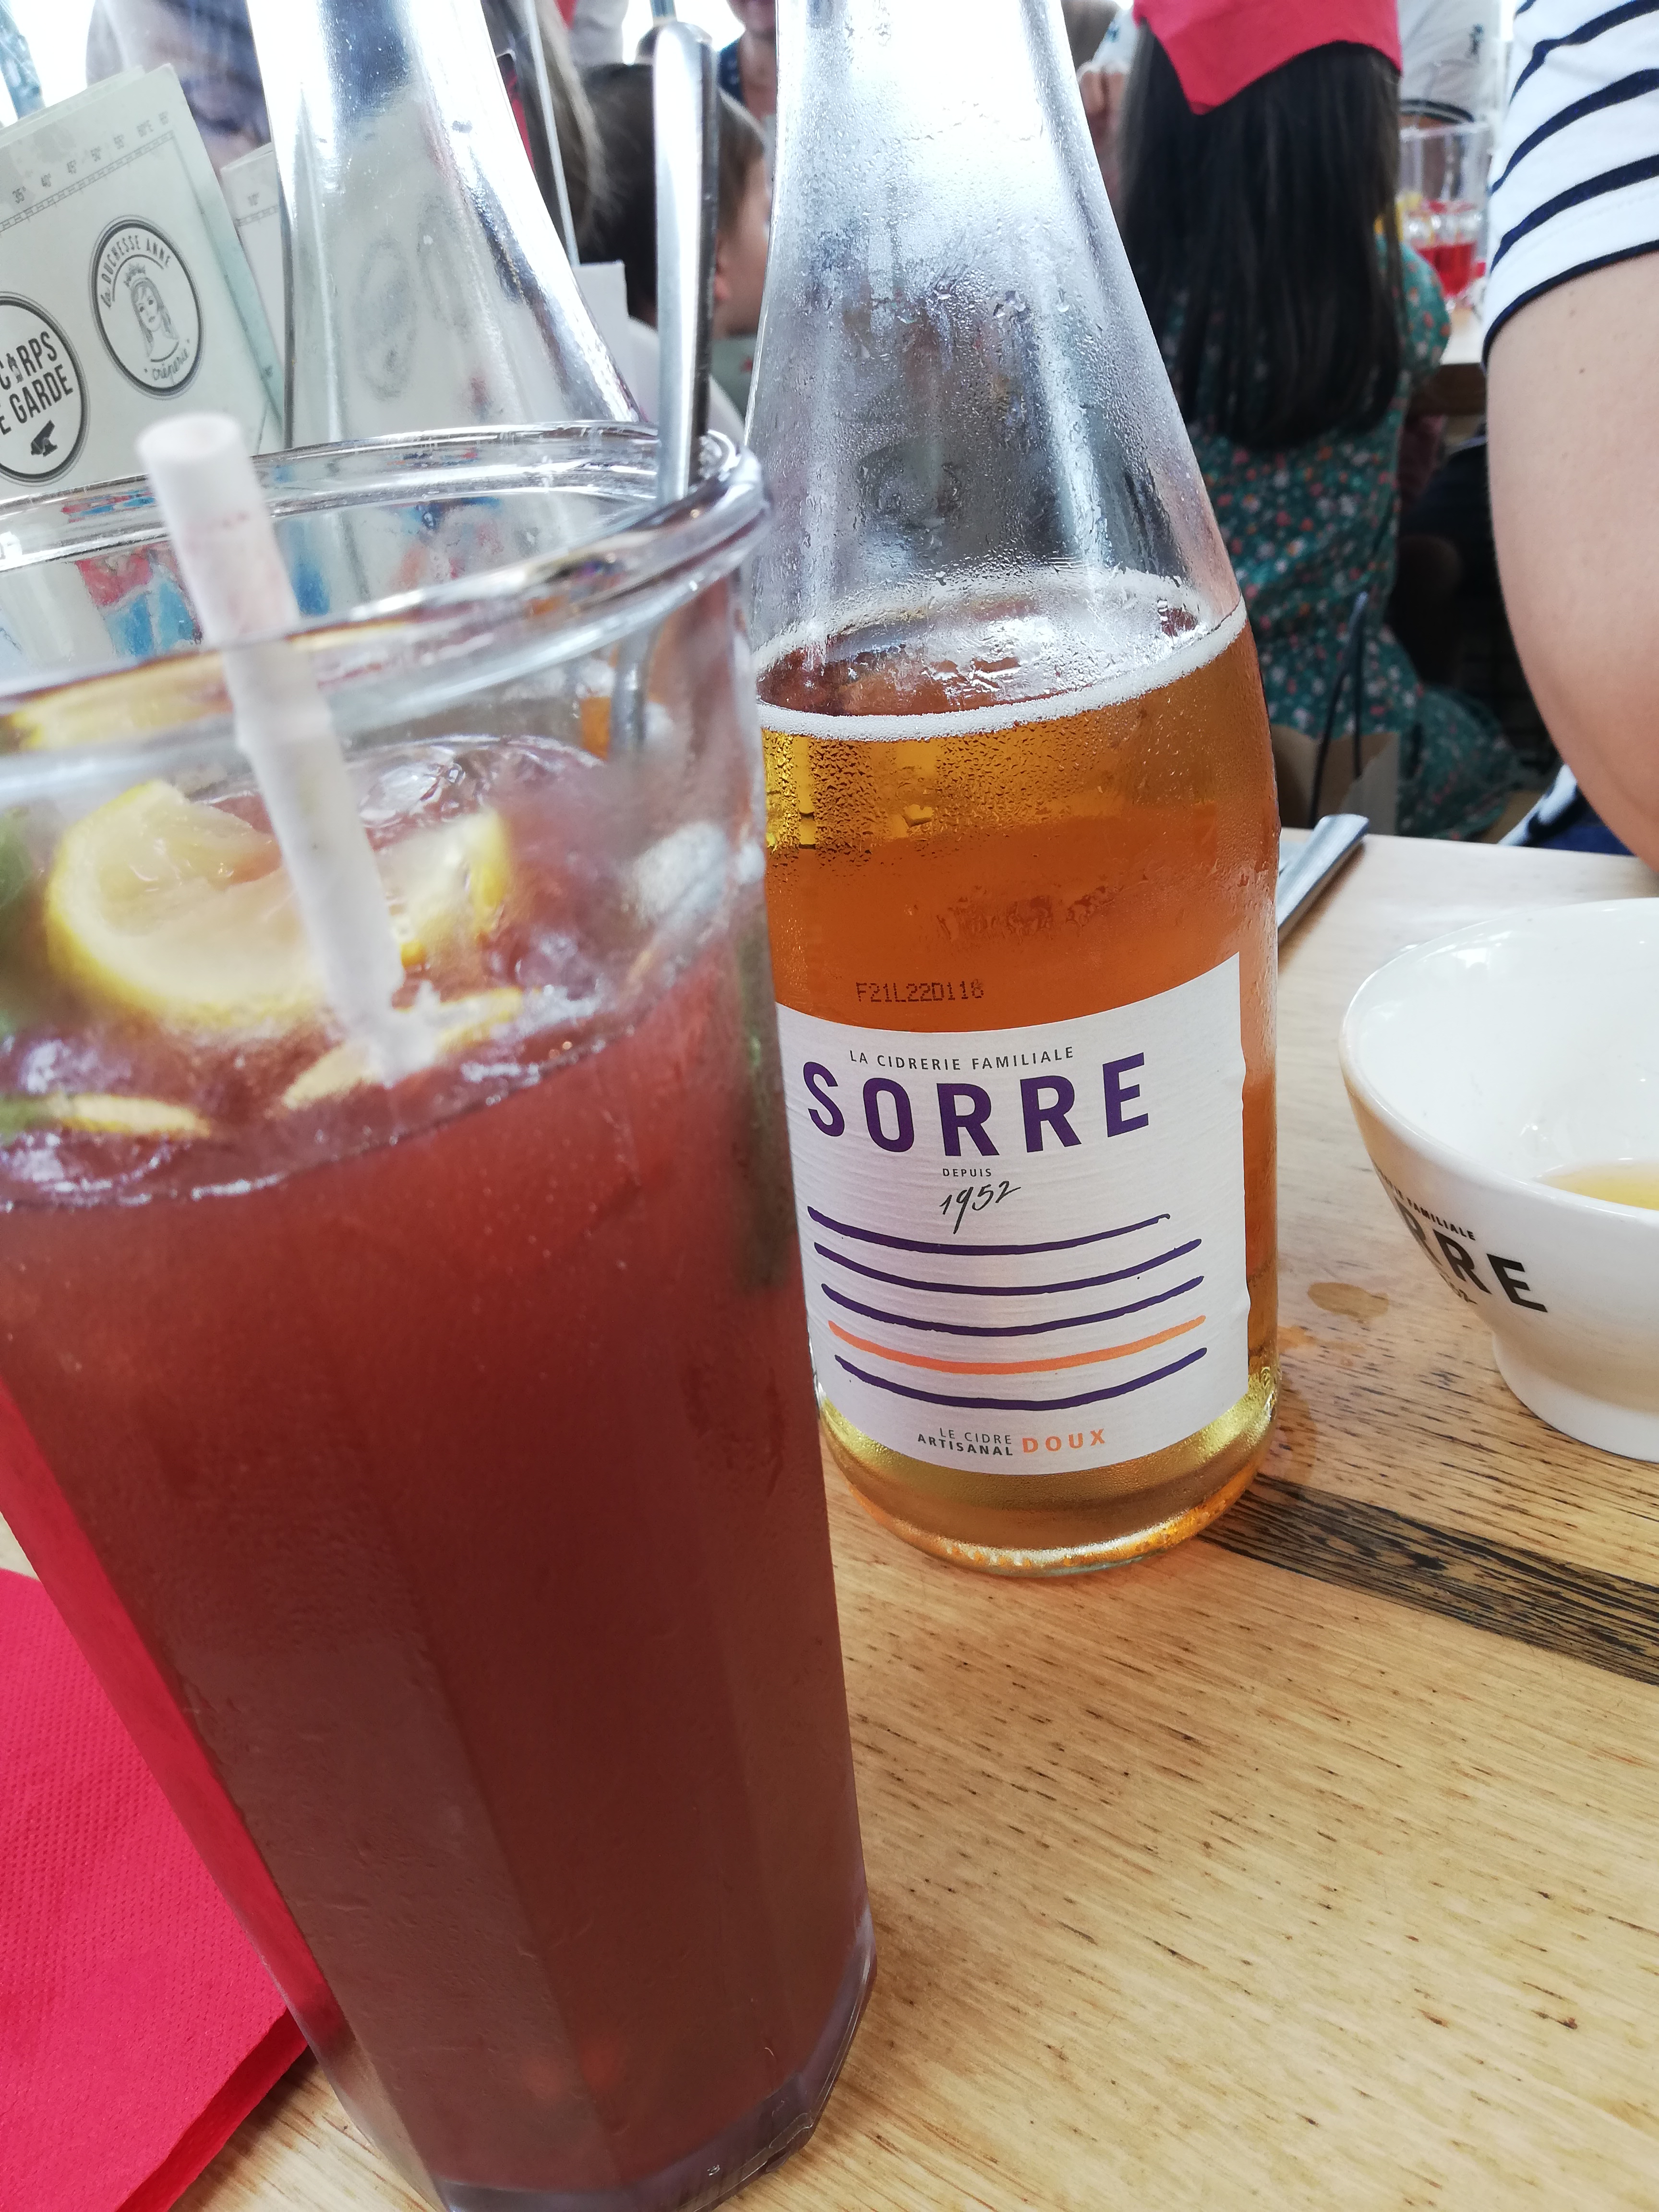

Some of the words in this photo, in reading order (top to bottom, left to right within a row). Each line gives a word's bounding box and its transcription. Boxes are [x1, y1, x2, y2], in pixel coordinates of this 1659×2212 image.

[100, 234, 141, 284] DUCHESSE
[145, 238, 171, 268] ANNE
[9, 363, 74, 424] GARDE
[849, 1049, 869, 1065] LA
[877, 1054, 961, 1071] CIDRERIE
[971, 1046, 1074, 1070] FAMILIALE
[802, 1051, 1150, 1158] SORRE
[942, 1167, 992, 1178] DEPUIS
[938, 1180, 1022, 1235] 1952
[1406, 1197, 1477, 1241] FAMILIALE
[1394, 1195, 1549, 1313] RRE
[917, 1433, 1013, 1456] ARTISANAL
[1022, 1429, 1106, 1454] DOUX
[939, 1427, 956, 1440] LE
[964, 1431, 1012, 1445] CIDRE
